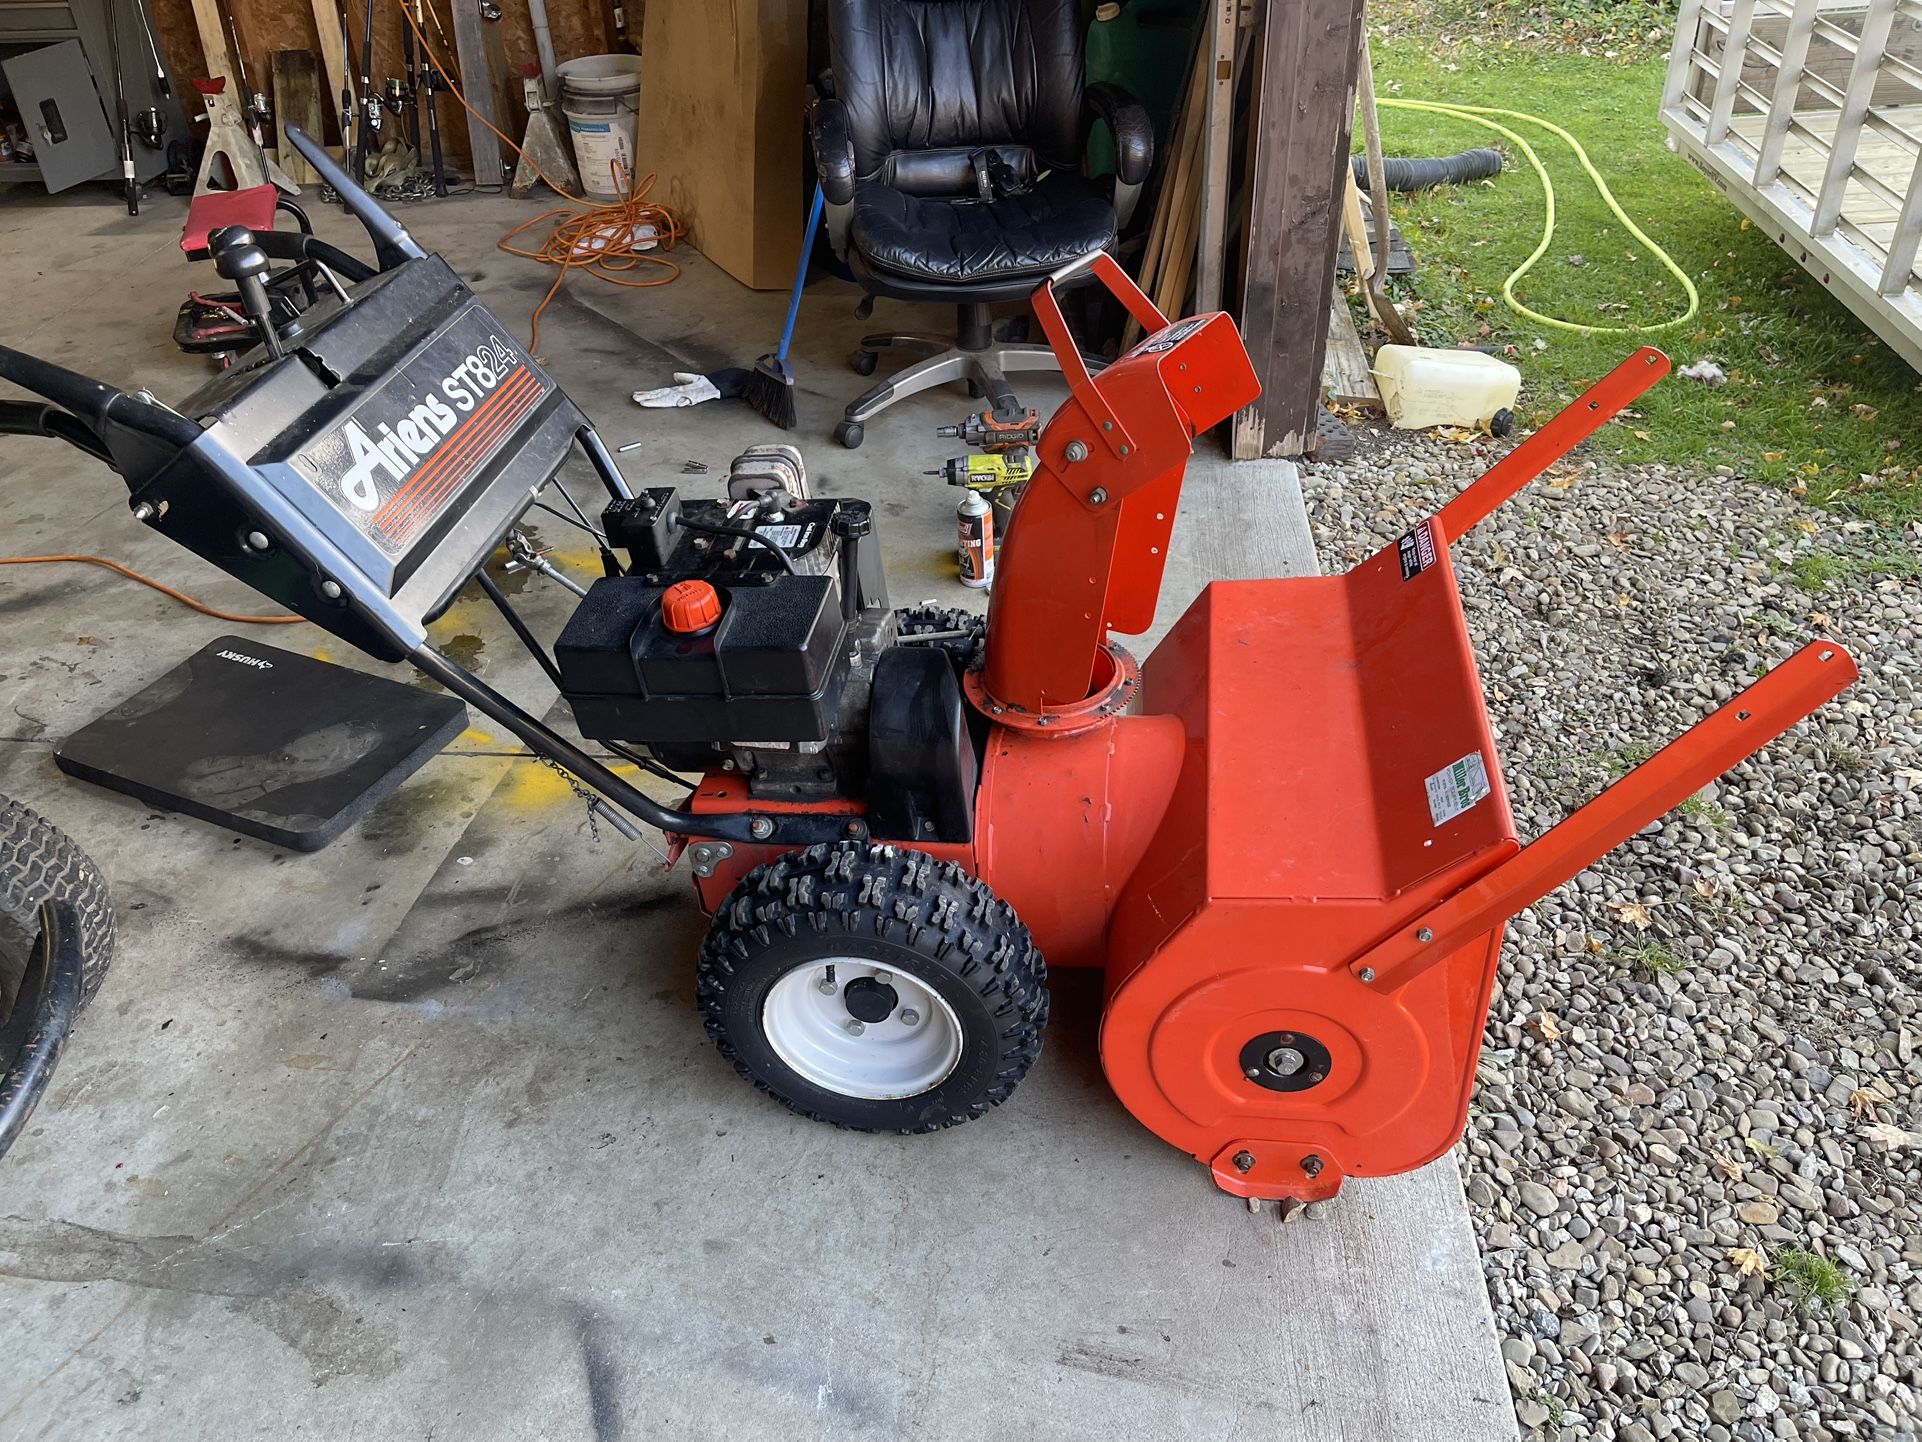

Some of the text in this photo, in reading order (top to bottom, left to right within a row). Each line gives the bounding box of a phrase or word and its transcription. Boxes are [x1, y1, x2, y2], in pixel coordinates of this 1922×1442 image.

[340, 335, 518, 511] Ariens ST824
[971, 474, 995, 482] RYOBI
[1417, 533, 1434, 567] DANGER
[216, 649, 259, 666] HUSKY
[1452, 760, 1467, 791] Miller
